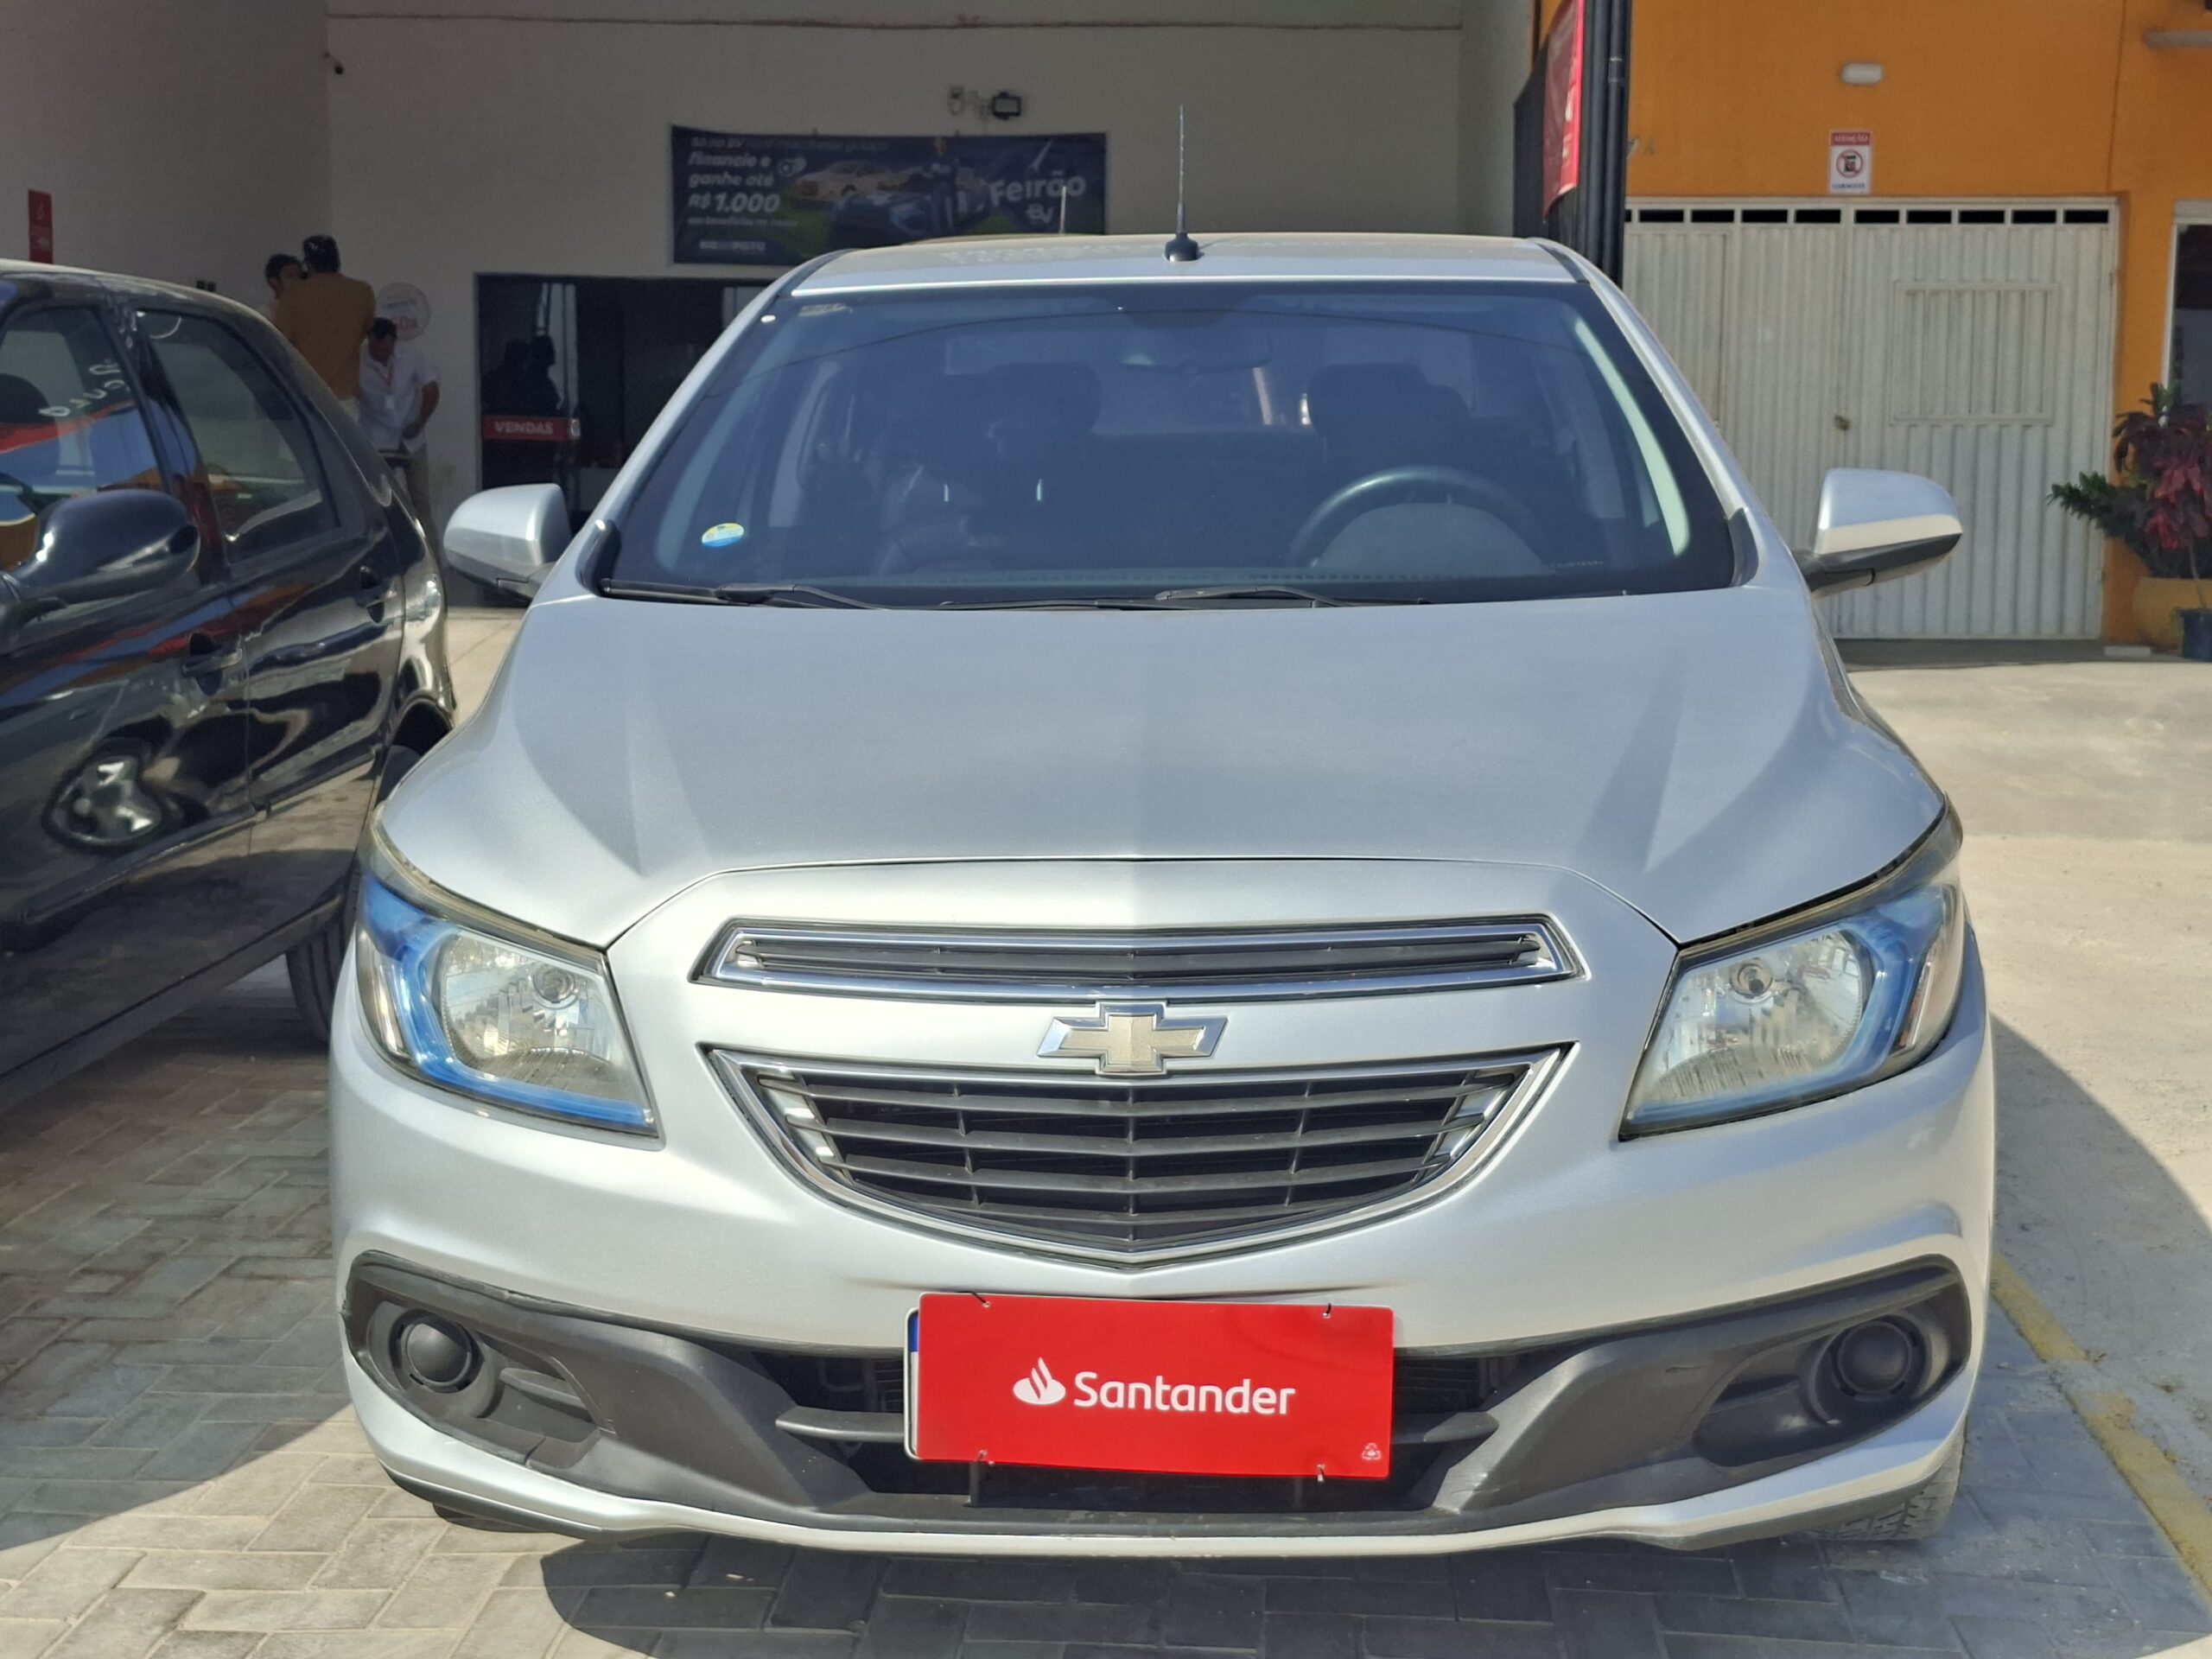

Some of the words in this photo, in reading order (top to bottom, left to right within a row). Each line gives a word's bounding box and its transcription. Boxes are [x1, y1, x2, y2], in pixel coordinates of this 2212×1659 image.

[760, 156, 772, 168] e
[688, 171, 743, 188] ganhe
[746, 172, 774, 187] até
[988, 170, 1087, 207] Feirão
[688, 192, 712, 209] R$
[715, 192, 781, 213] 1.000
[494, 421, 554, 435] VENDAS
[1073, 1370, 1297, 1415] Santander
